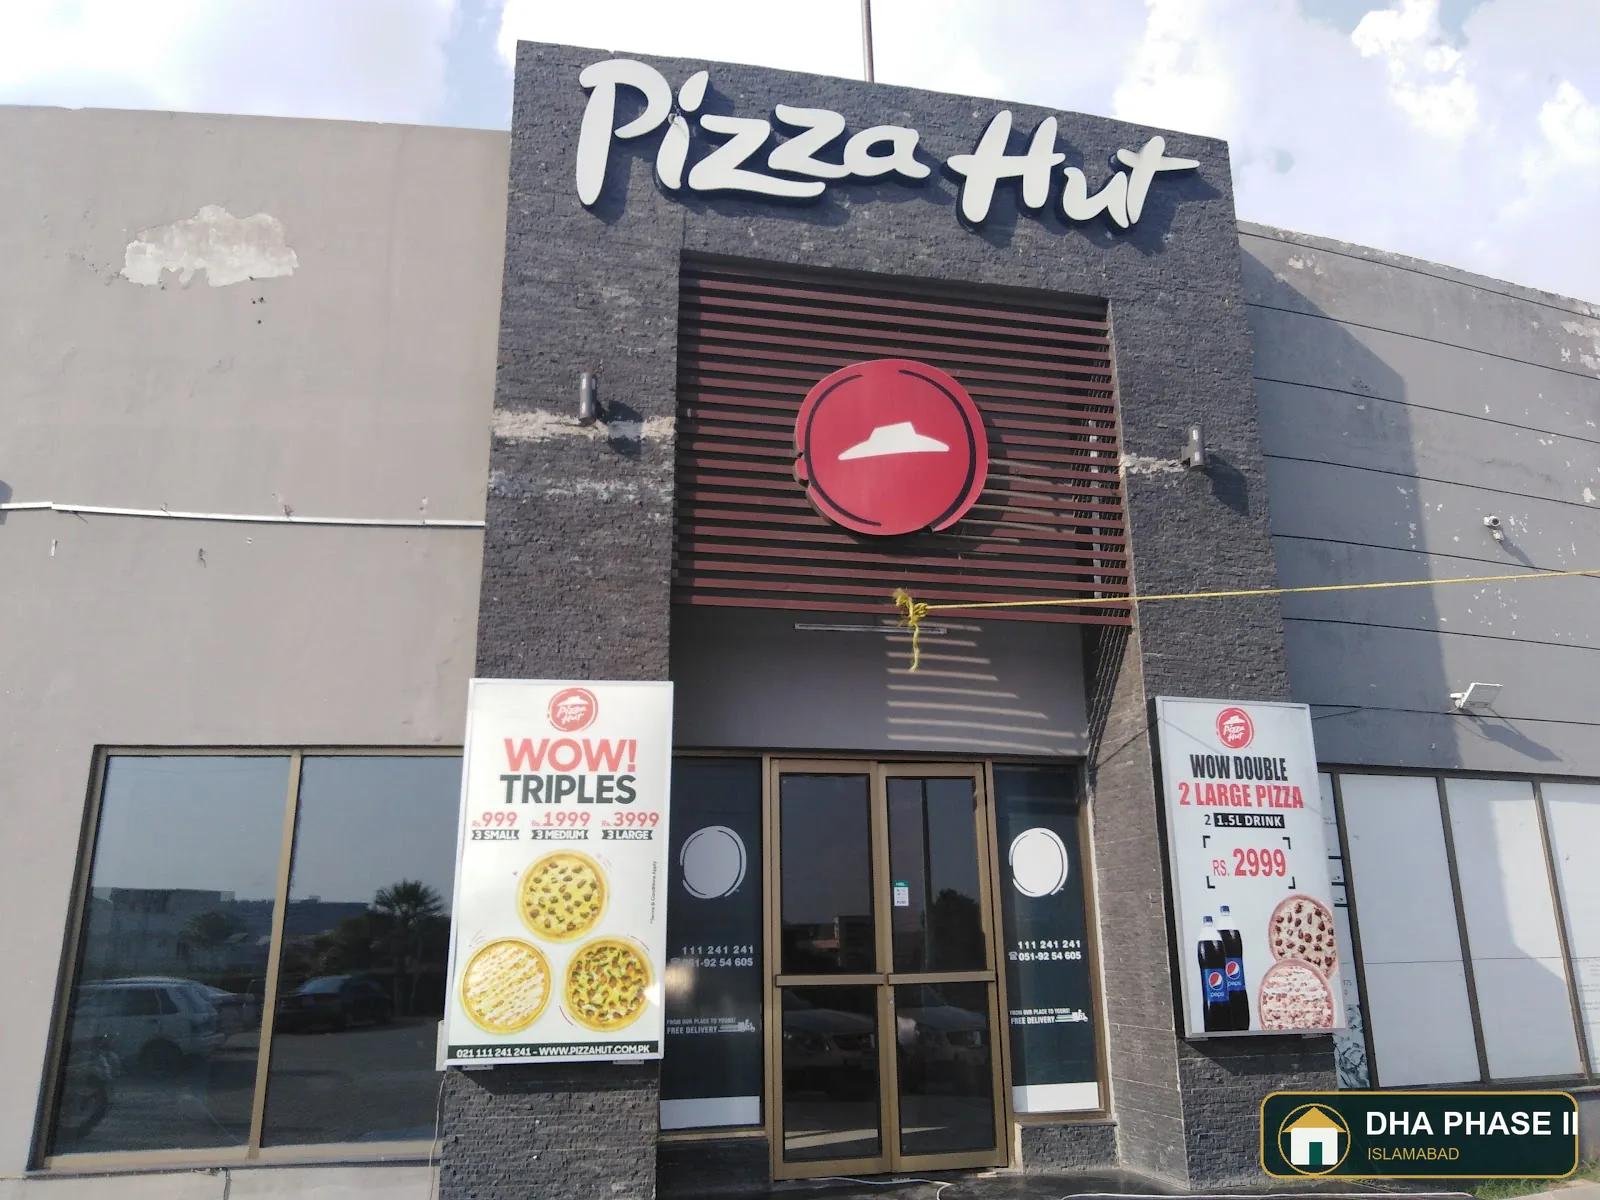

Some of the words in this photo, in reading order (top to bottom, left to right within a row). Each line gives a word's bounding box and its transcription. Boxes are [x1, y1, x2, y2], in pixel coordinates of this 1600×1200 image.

[575, 58, 931, 206] Pizza
[946, 109, 1200, 229] Hut
[556, 704, 587, 719] Pizza
[561, 712, 585, 725] Hut
[1223, 723, 1246, 736] Pizza
[1227, 731, 1245, 743] Hut
[503, 738, 637, 773] WOW!
[1189, 754, 1231, 780] WOW
[1234, 756, 1289, 782] DOUBLE
[499, 774, 637, 805] TRIPLES
[1178, 781, 1191, 806] 2
[1194, 782, 1253, 808] LARGE
[1256, 785, 1305, 809] PIZZA
[543, 811, 591, 827] 1999
[613, 811, 660, 828] 3999
[1204, 814, 1212, 826] 2
[1216, 815, 1243, 827] 1.5L
[1244, 815, 1283, 828] DRINK
[474, 830, 482, 840] 3
[484, 830, 517, 840] SMALL
[536, 830, 543, 840] 3
[545, 830, 586, 840] MEDIUM
[607, 830, 614, 840] 3
[616, 830, 649, 840] LARGE
[1212, 859, 1230, 877] RS.
[1232, 848, 1287, 877] 2999
[682, 945, 703, 955] 111
[707, 945, 729, 955] 241
[733, 944, 754, 954] 241
[1018, 940, 1036, 949] 111
[1040, 940, 1059, 949] 241
[1062, 939, 1081, 948] 241
[719, 957, 732, 967] 54
[734, 957, 754, 967] 605
[1018, 951, 1050, 961] 051-92
[1051, 951, 1063, 960] 54
[1064, 951, 1082, 960] 605
[1010, 1016, 1026, 1025] FREE
[1027, 1015, 1055, 1024] DELIVERY
[666, 1026, 684, 1035] FREE
[685, 1025, 718, 1034] DELIVERY
[456, 1048, 474, 1058] 021
[475, 1048, 493, 1058] 111
[494, 1047, 513, 1058] 241
[514, 1047, 531, 1057] 241
[539, 1045, 650, 1056] WWW.PIZZAHUT.COM.PK
